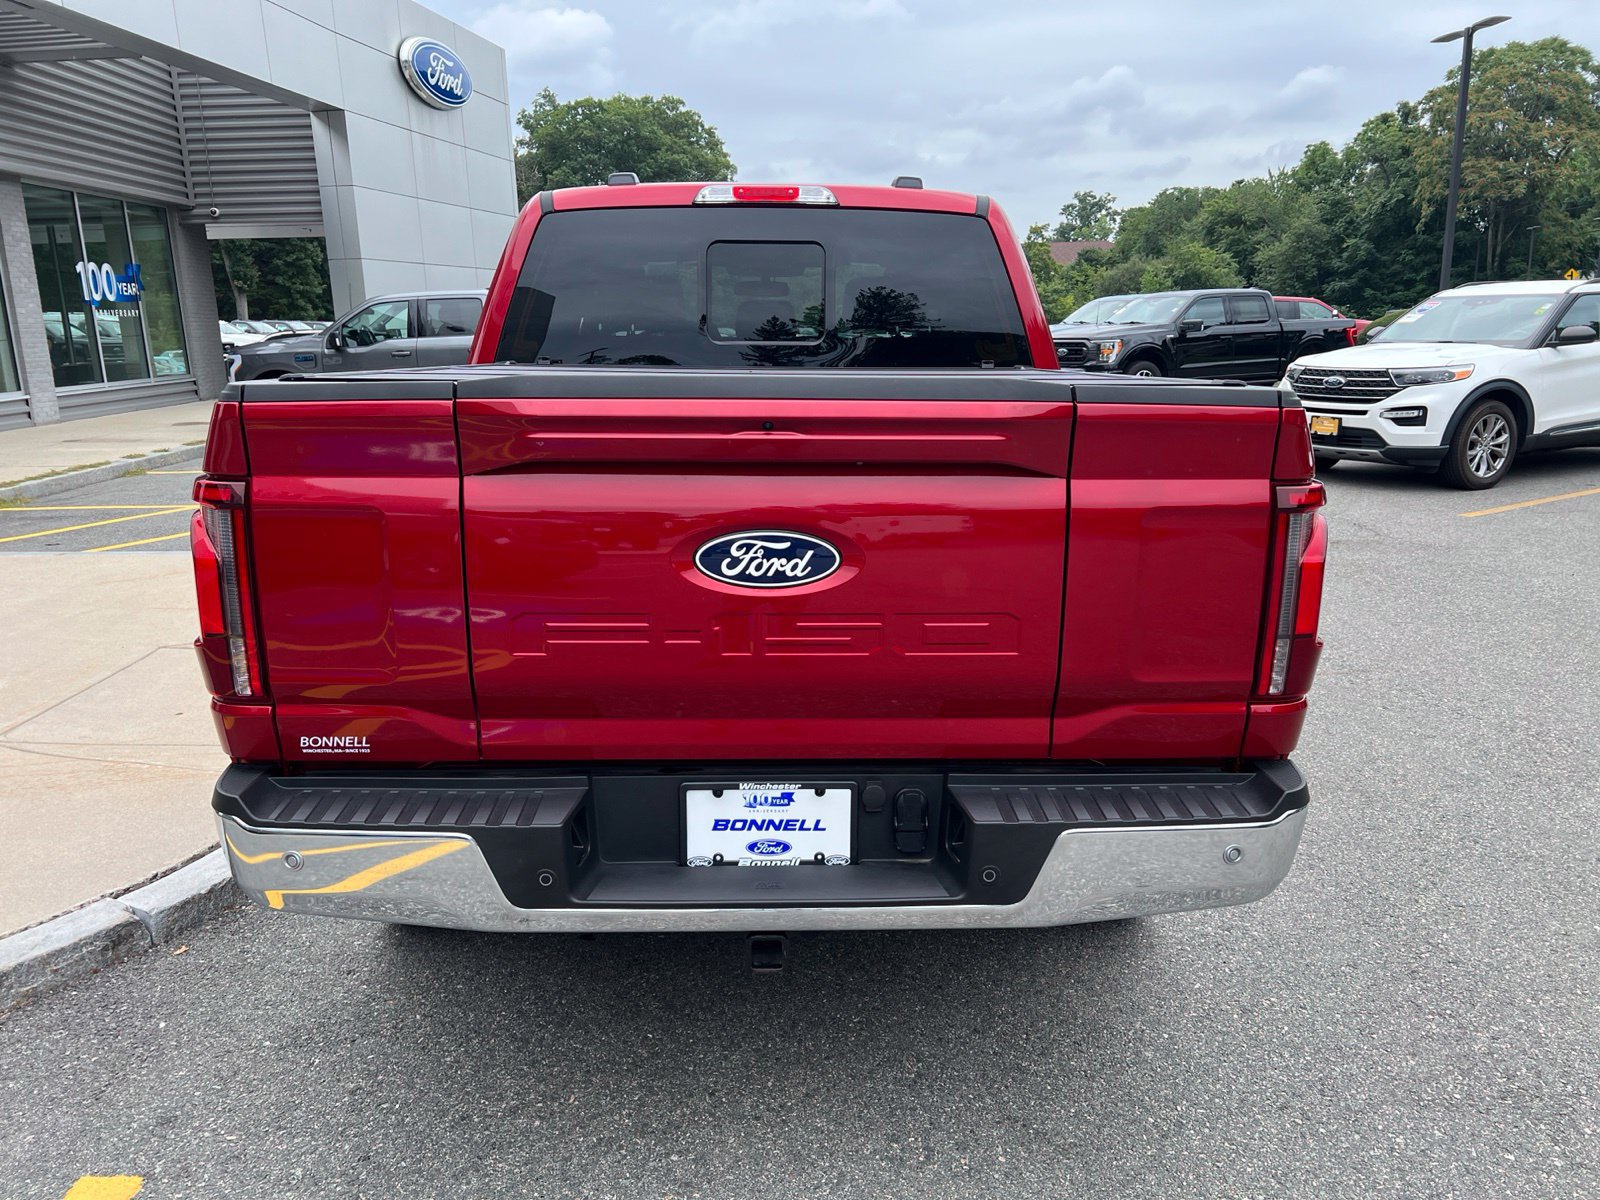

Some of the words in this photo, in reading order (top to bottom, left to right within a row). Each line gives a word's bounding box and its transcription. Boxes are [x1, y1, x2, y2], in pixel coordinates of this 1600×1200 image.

[427, 52, 463, 96] Ford
[75, 261, 117, 301] 100
[721, 539, 814, 578] Ford
[511, 612, 1020, 657] F-150
[300, 736, 371, 747] BONNELL
[743, 792, 772, 807] 100
[712, 819, 826, 831] BONNELL
[754, 841, 784, 854] Ford
